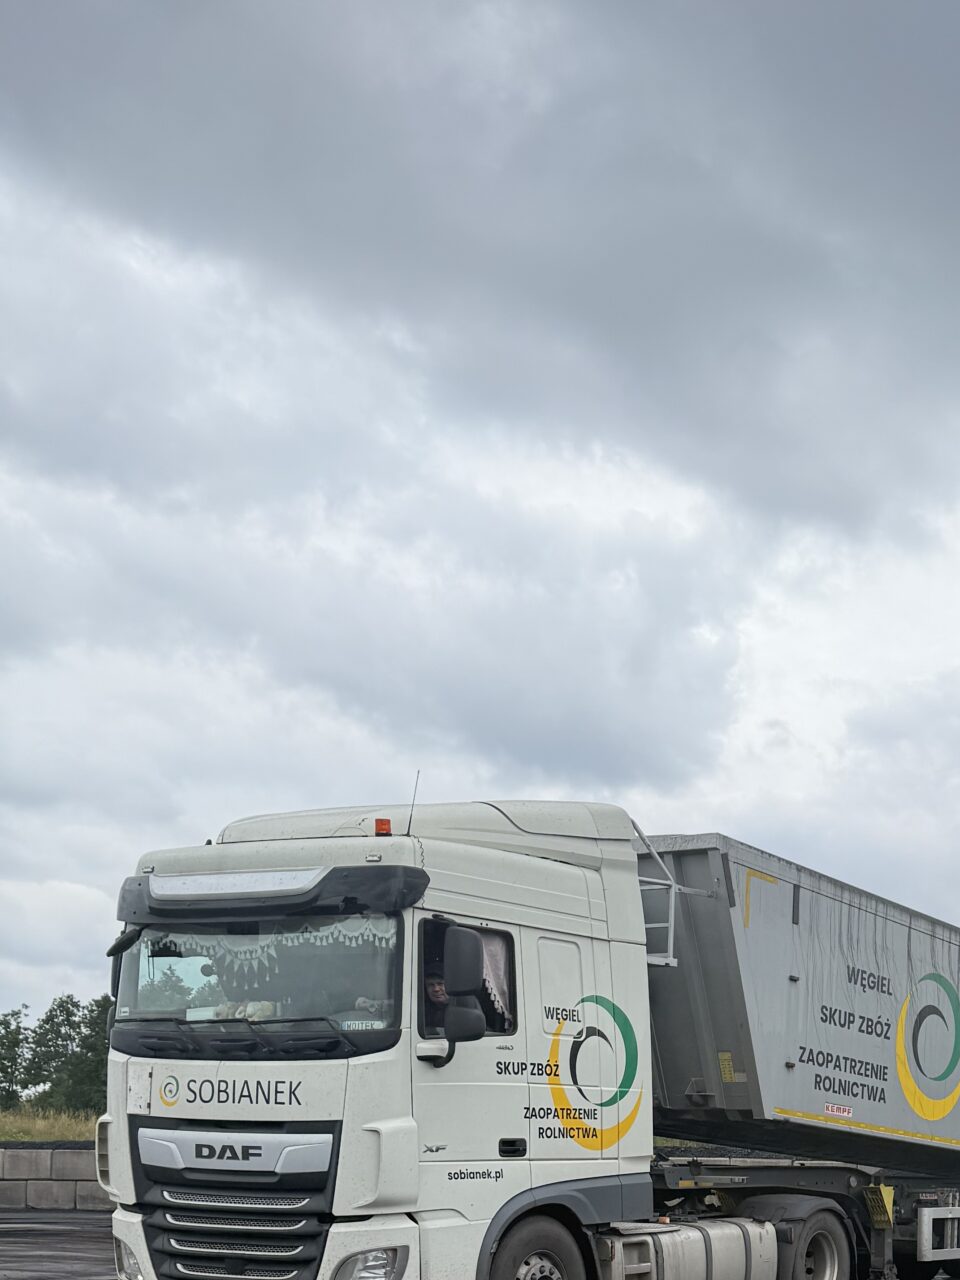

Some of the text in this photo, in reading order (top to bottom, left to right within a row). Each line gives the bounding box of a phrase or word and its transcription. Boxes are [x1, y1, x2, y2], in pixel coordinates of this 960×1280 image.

[847, 965, 892, 996] WĘGIEL
[544, 1006, 581, 1024] WĘGIEL
[820, 1005, 891, 1040] SKUP ZBÓŻ
[496, 1060, 560, 1077] SKUP ZBÓŻ
[799, 1046, 888, 1082] ZAOPATRZENIE
[186, 1079, 302, 1106] SOBIANEK
[814, 1073, 886, 1104] ROLNICTWA
[524, 1107, 598, 1120] ZAOPATRZENIE
[825, 1104, 852, 1116] KEMPF
[538, 1127, 598, 1139] ROLNICTWA
[195, 1144, 262, 1160] DAF
[423, 1144, 448, 1153] XF
[448, 1168, 503, 1182] sobianek.pl
